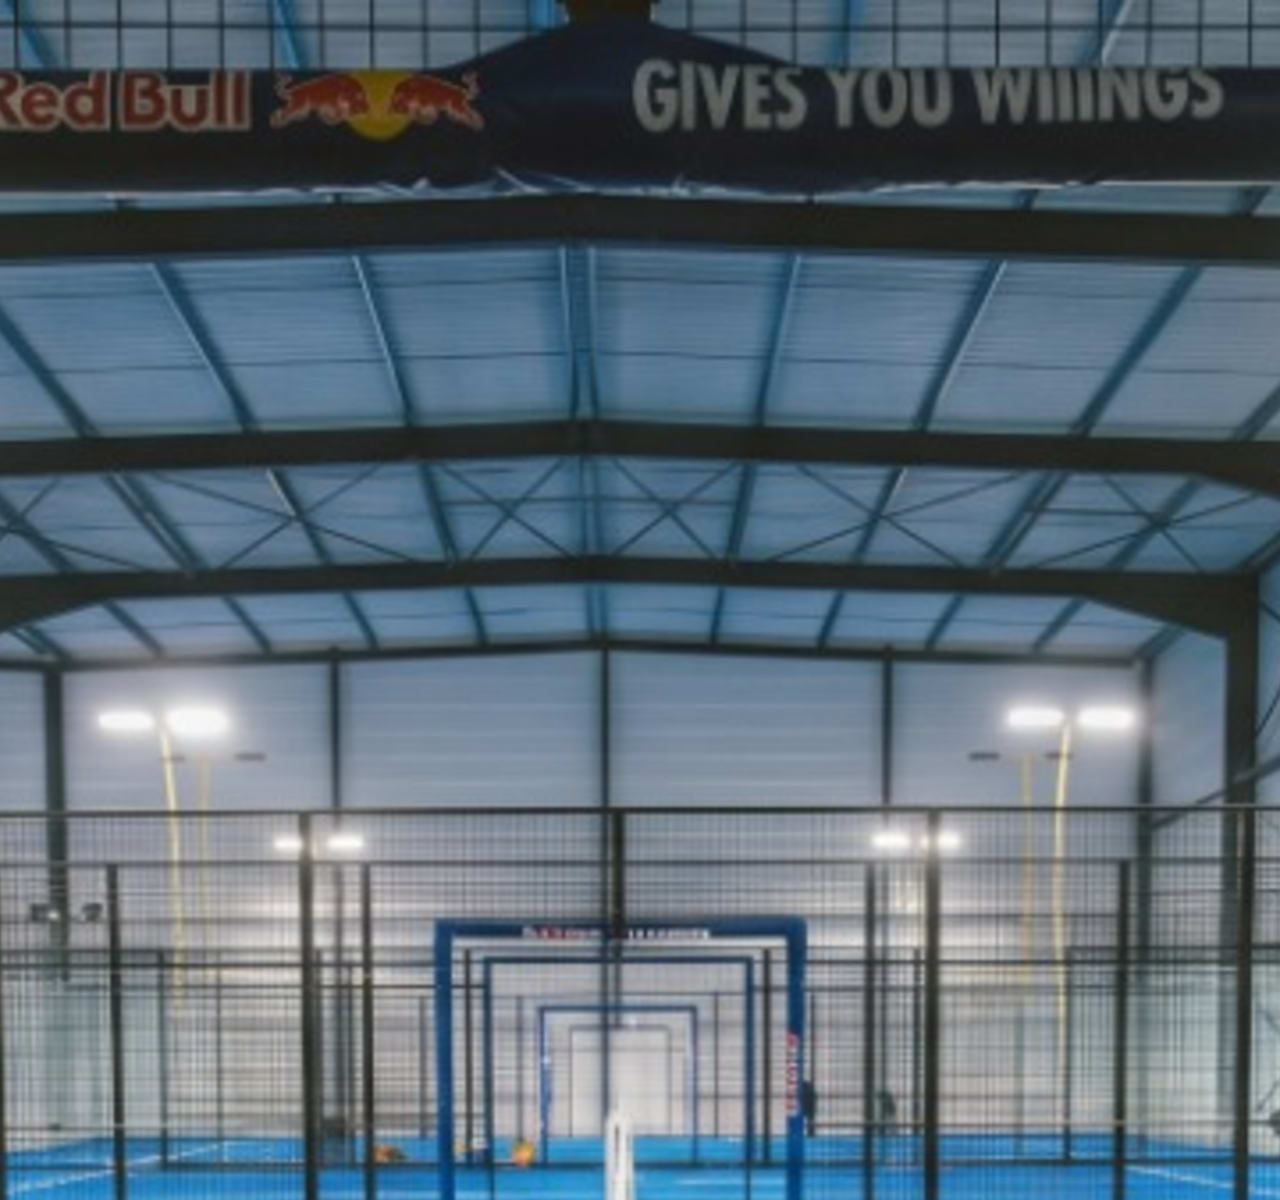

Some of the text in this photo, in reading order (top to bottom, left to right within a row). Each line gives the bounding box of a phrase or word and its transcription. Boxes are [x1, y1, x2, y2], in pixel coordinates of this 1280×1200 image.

[117, 71, 252, 132] Bull
[631, 59, 808, 132] GIVES
[826, 67, 952, 129] YOU
